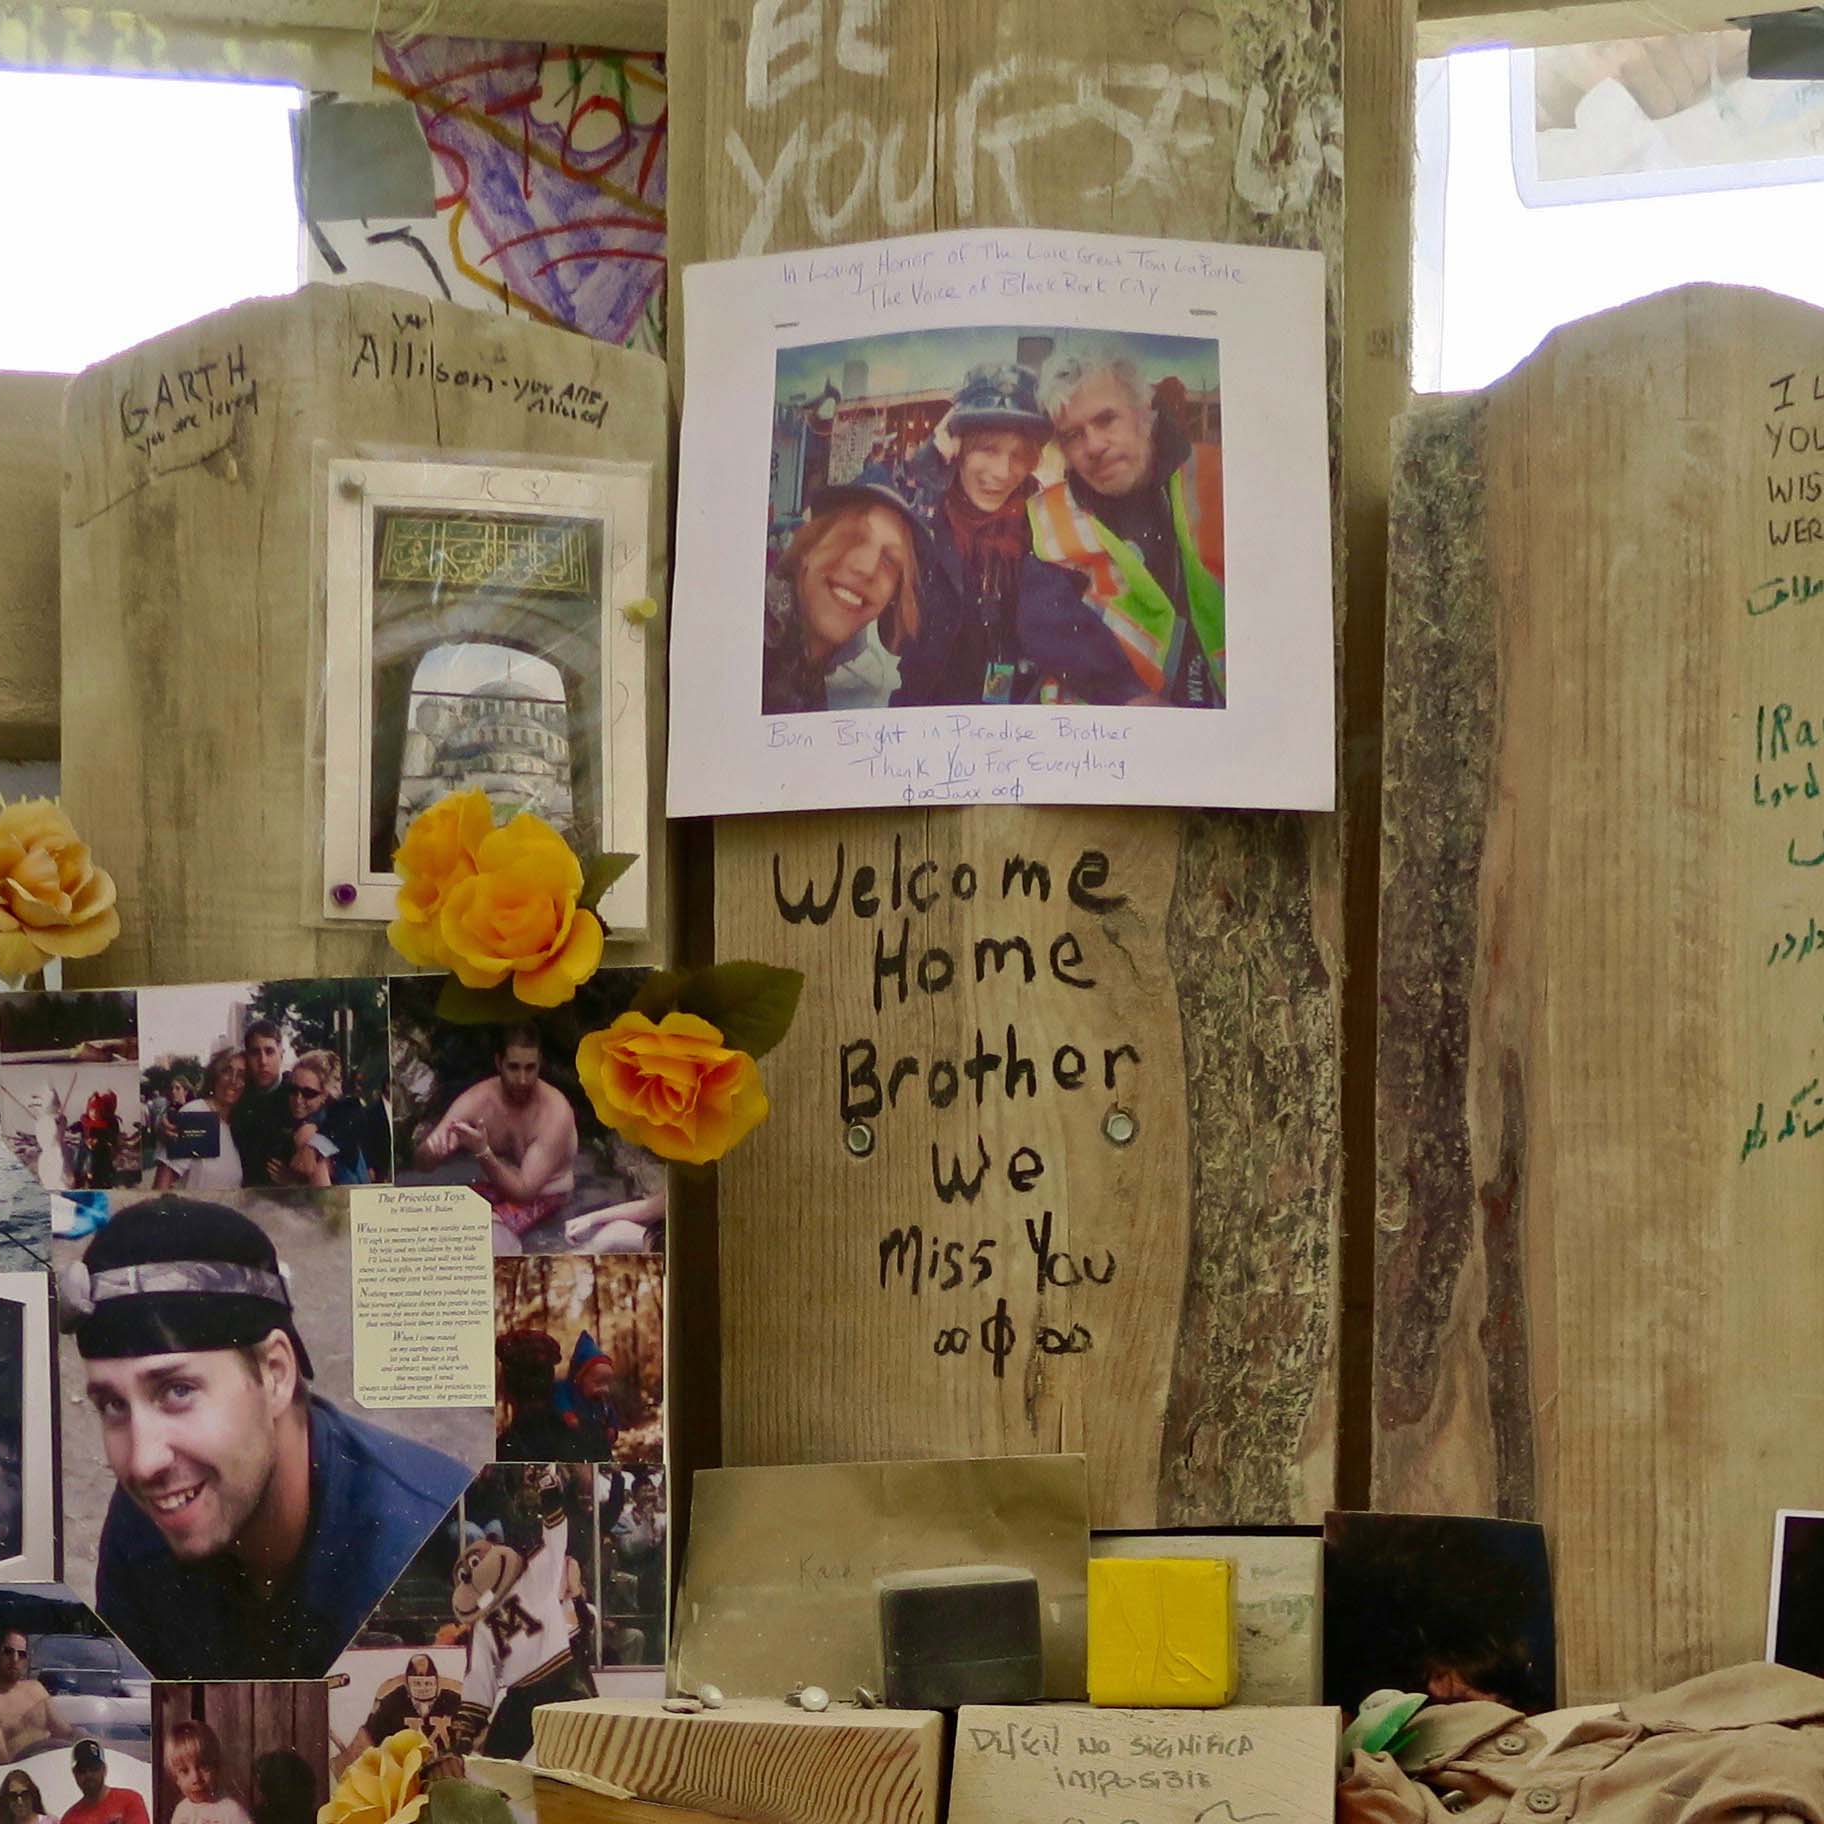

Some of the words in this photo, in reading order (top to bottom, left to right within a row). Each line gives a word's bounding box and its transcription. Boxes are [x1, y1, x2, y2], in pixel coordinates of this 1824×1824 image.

[1769, 371, 1797, 413] I
[873, 917, 1098, 1013] Home
[838, 1024, 1143, 1125] Brother
